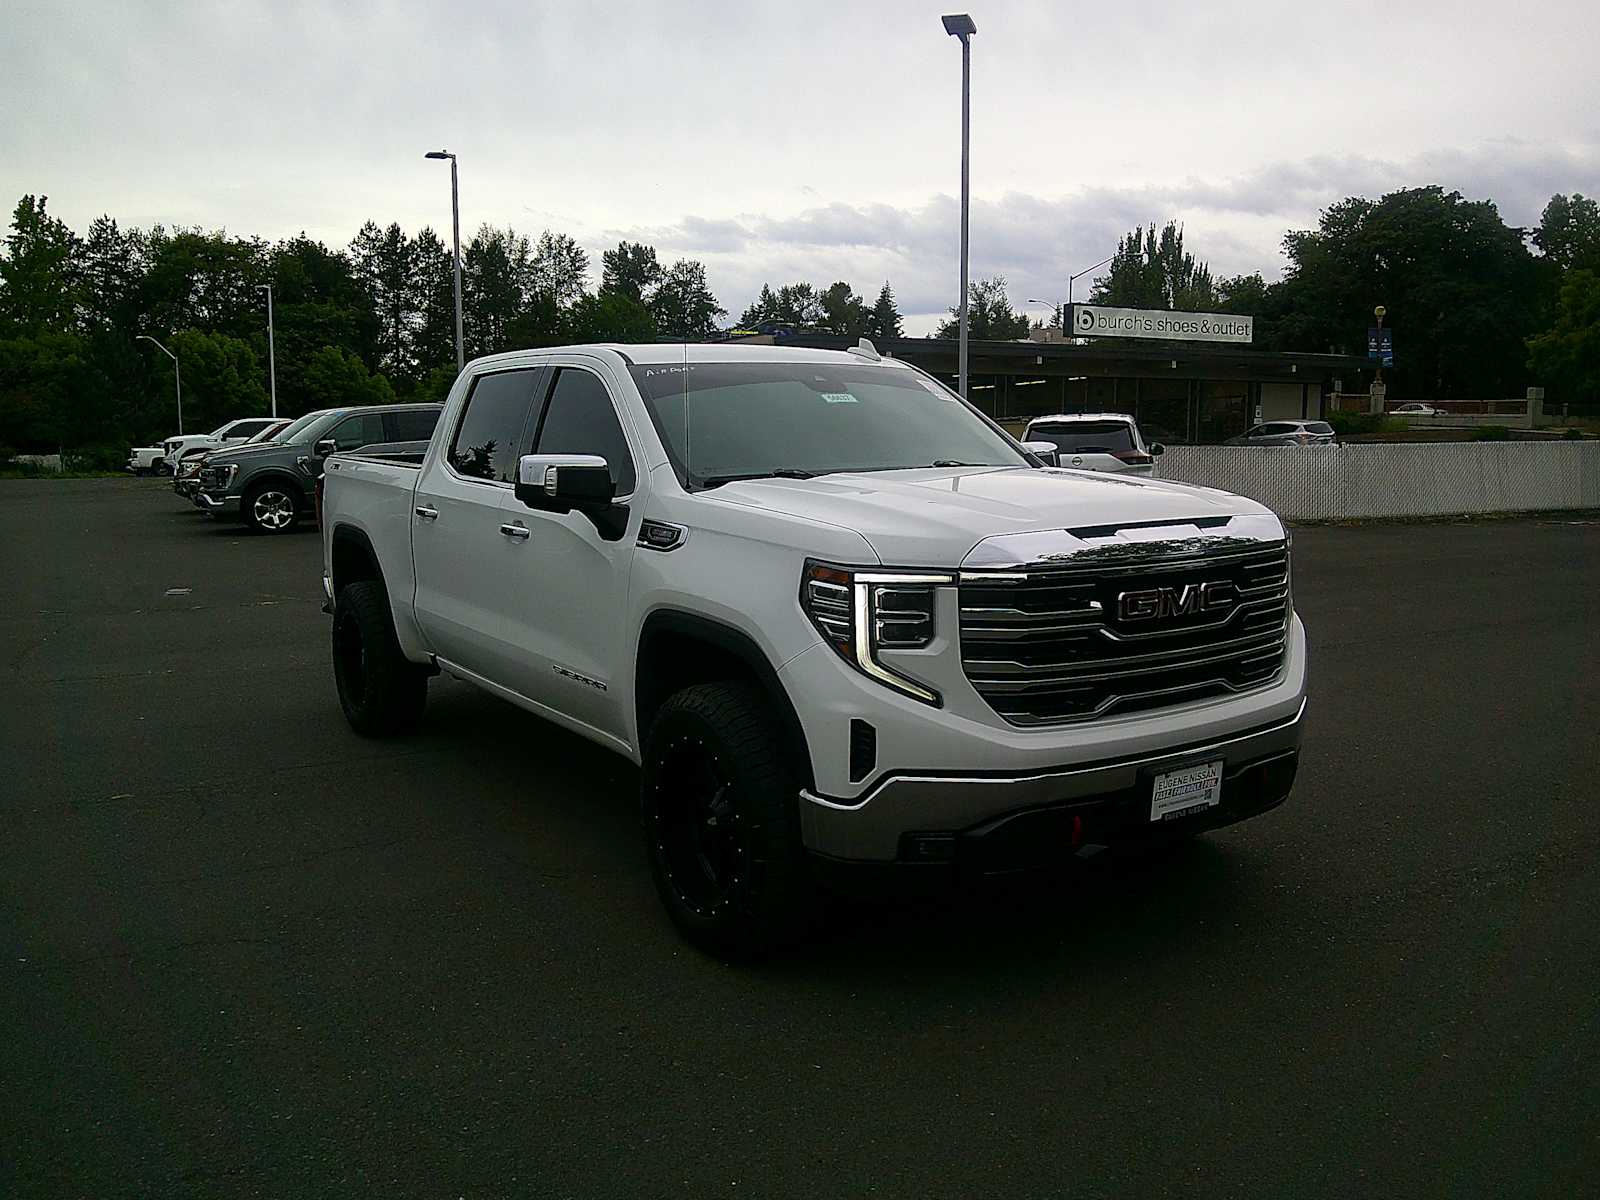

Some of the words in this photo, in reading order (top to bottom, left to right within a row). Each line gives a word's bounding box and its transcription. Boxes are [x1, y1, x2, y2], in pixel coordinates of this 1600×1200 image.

[1097, 313, 1152, 331] burch's
[1157, 317, 1198, 333] shoes
[1200, 319, 1211, 334] &
[1212, 321, 1250, 336] outlet
[1117, 579, 1233, 621] GMC
[1189, 767, 1217, 784] NISSAN
